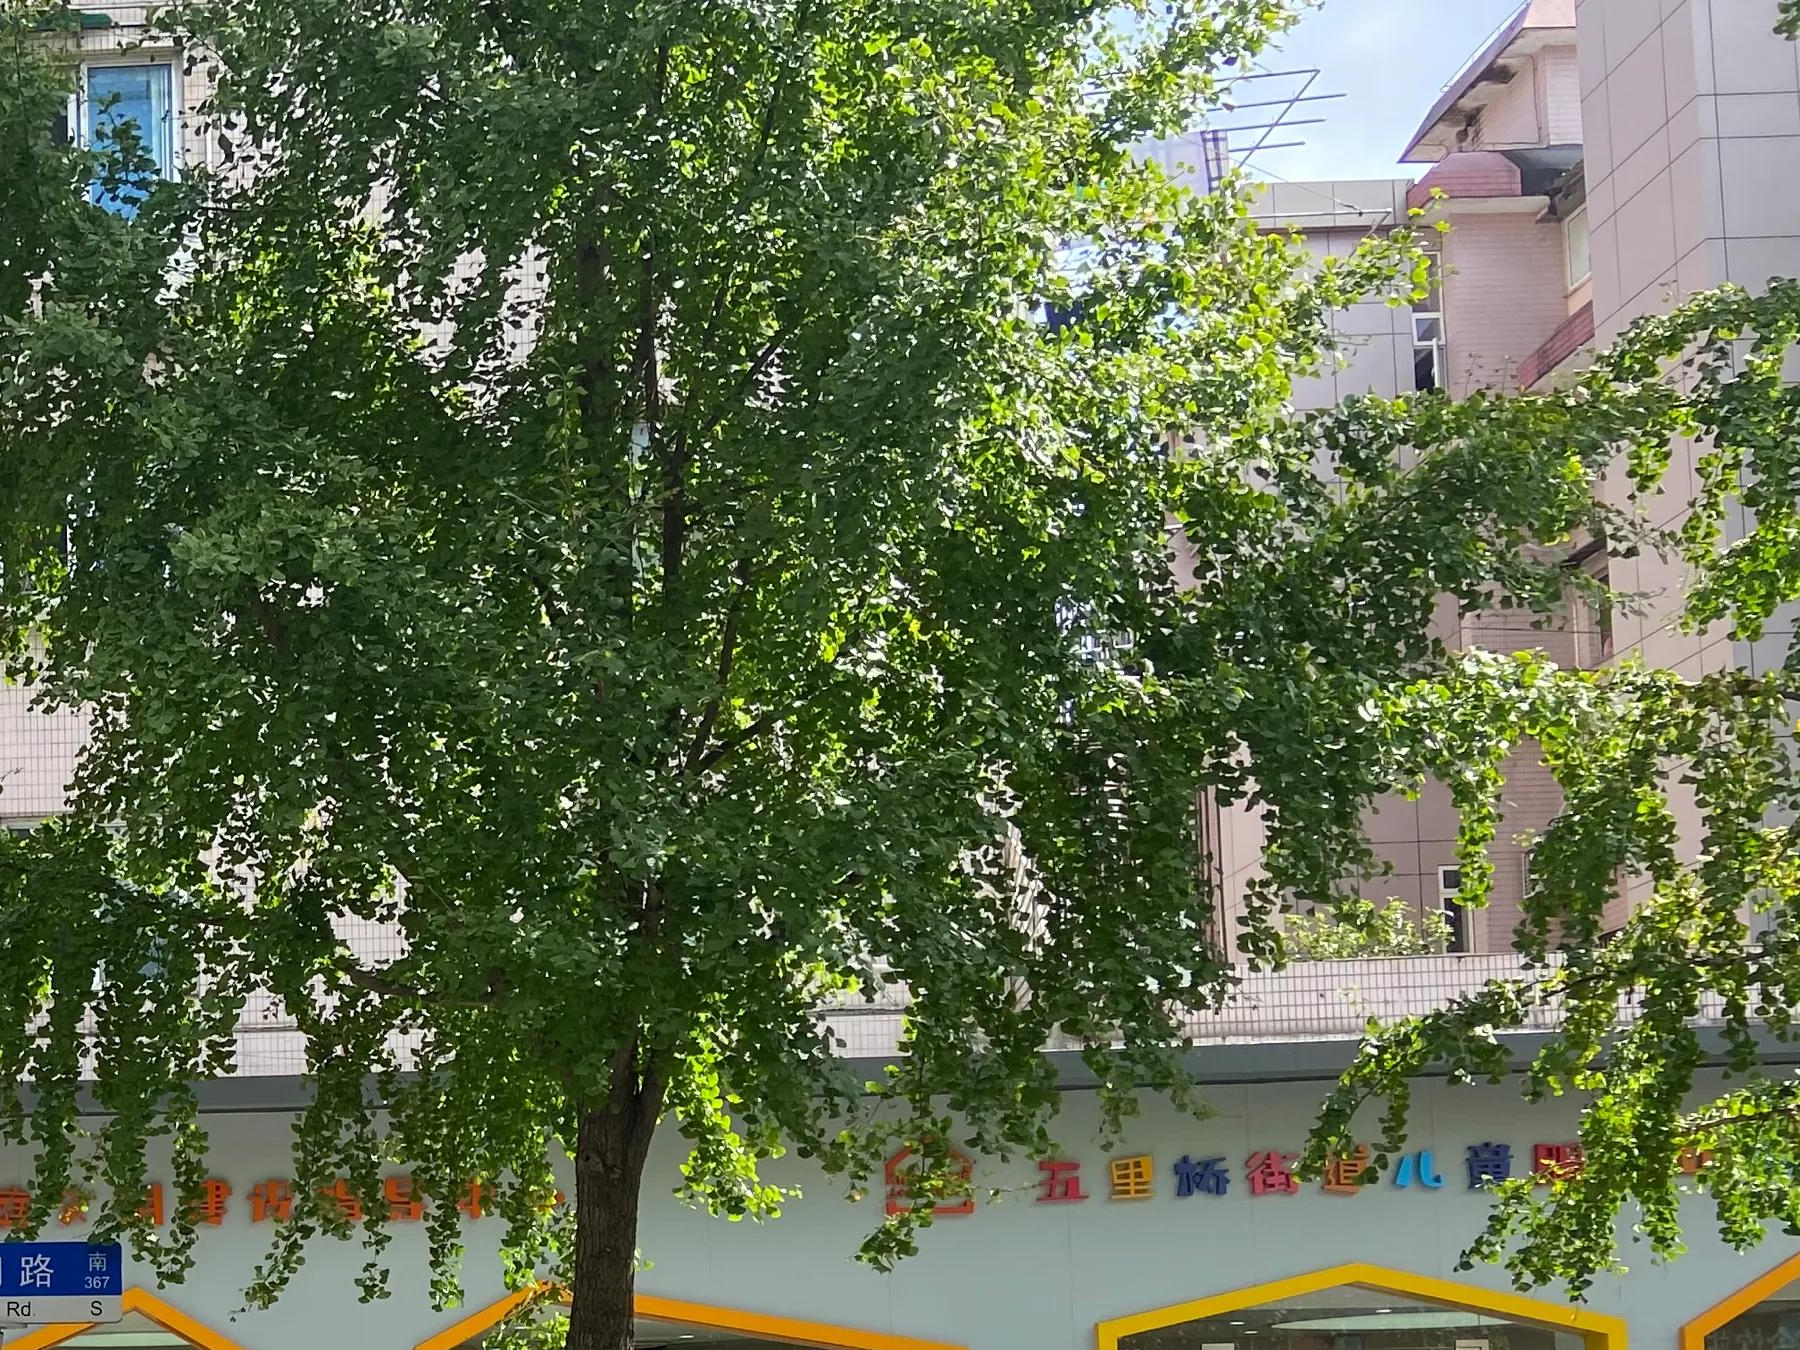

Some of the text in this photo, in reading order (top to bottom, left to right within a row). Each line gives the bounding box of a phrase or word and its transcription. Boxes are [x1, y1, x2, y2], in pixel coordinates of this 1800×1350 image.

[88, 1252, 107, 1272] 南
[84, 1276, 110, 1289] 367
[90, 1301, 103, 1316] S
